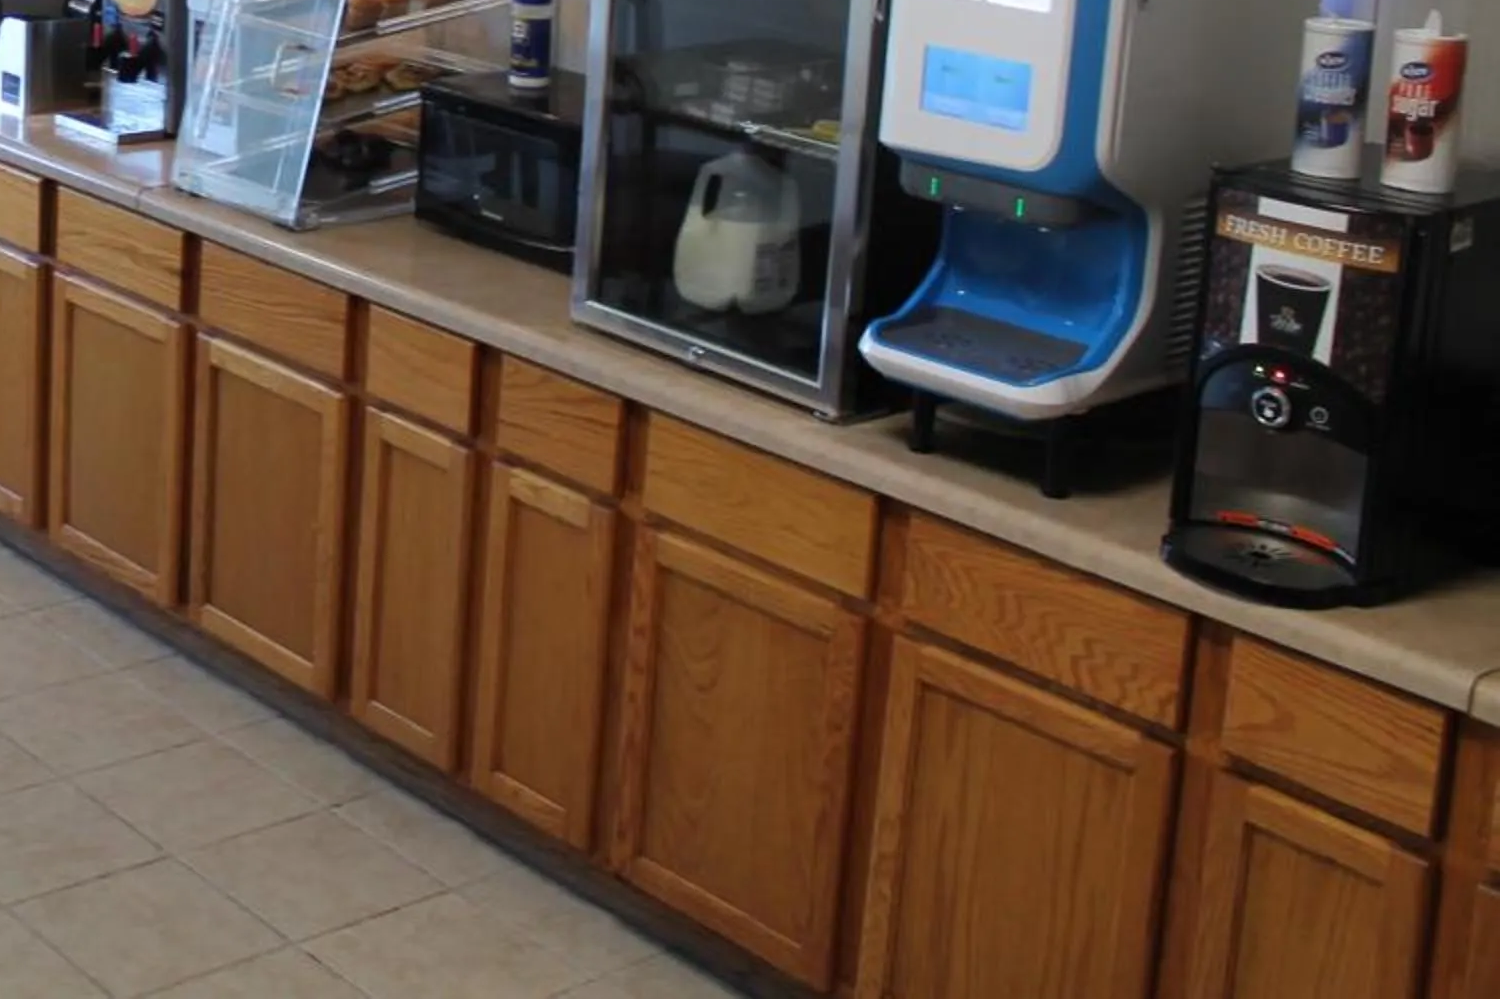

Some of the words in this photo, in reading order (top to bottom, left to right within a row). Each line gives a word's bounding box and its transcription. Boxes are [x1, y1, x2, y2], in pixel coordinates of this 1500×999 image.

[1392, 94, 1440, 122] sugar
[1225, 213, 1288, 246] FRESH
[1293, 231, 1386, 265] COFFEE
